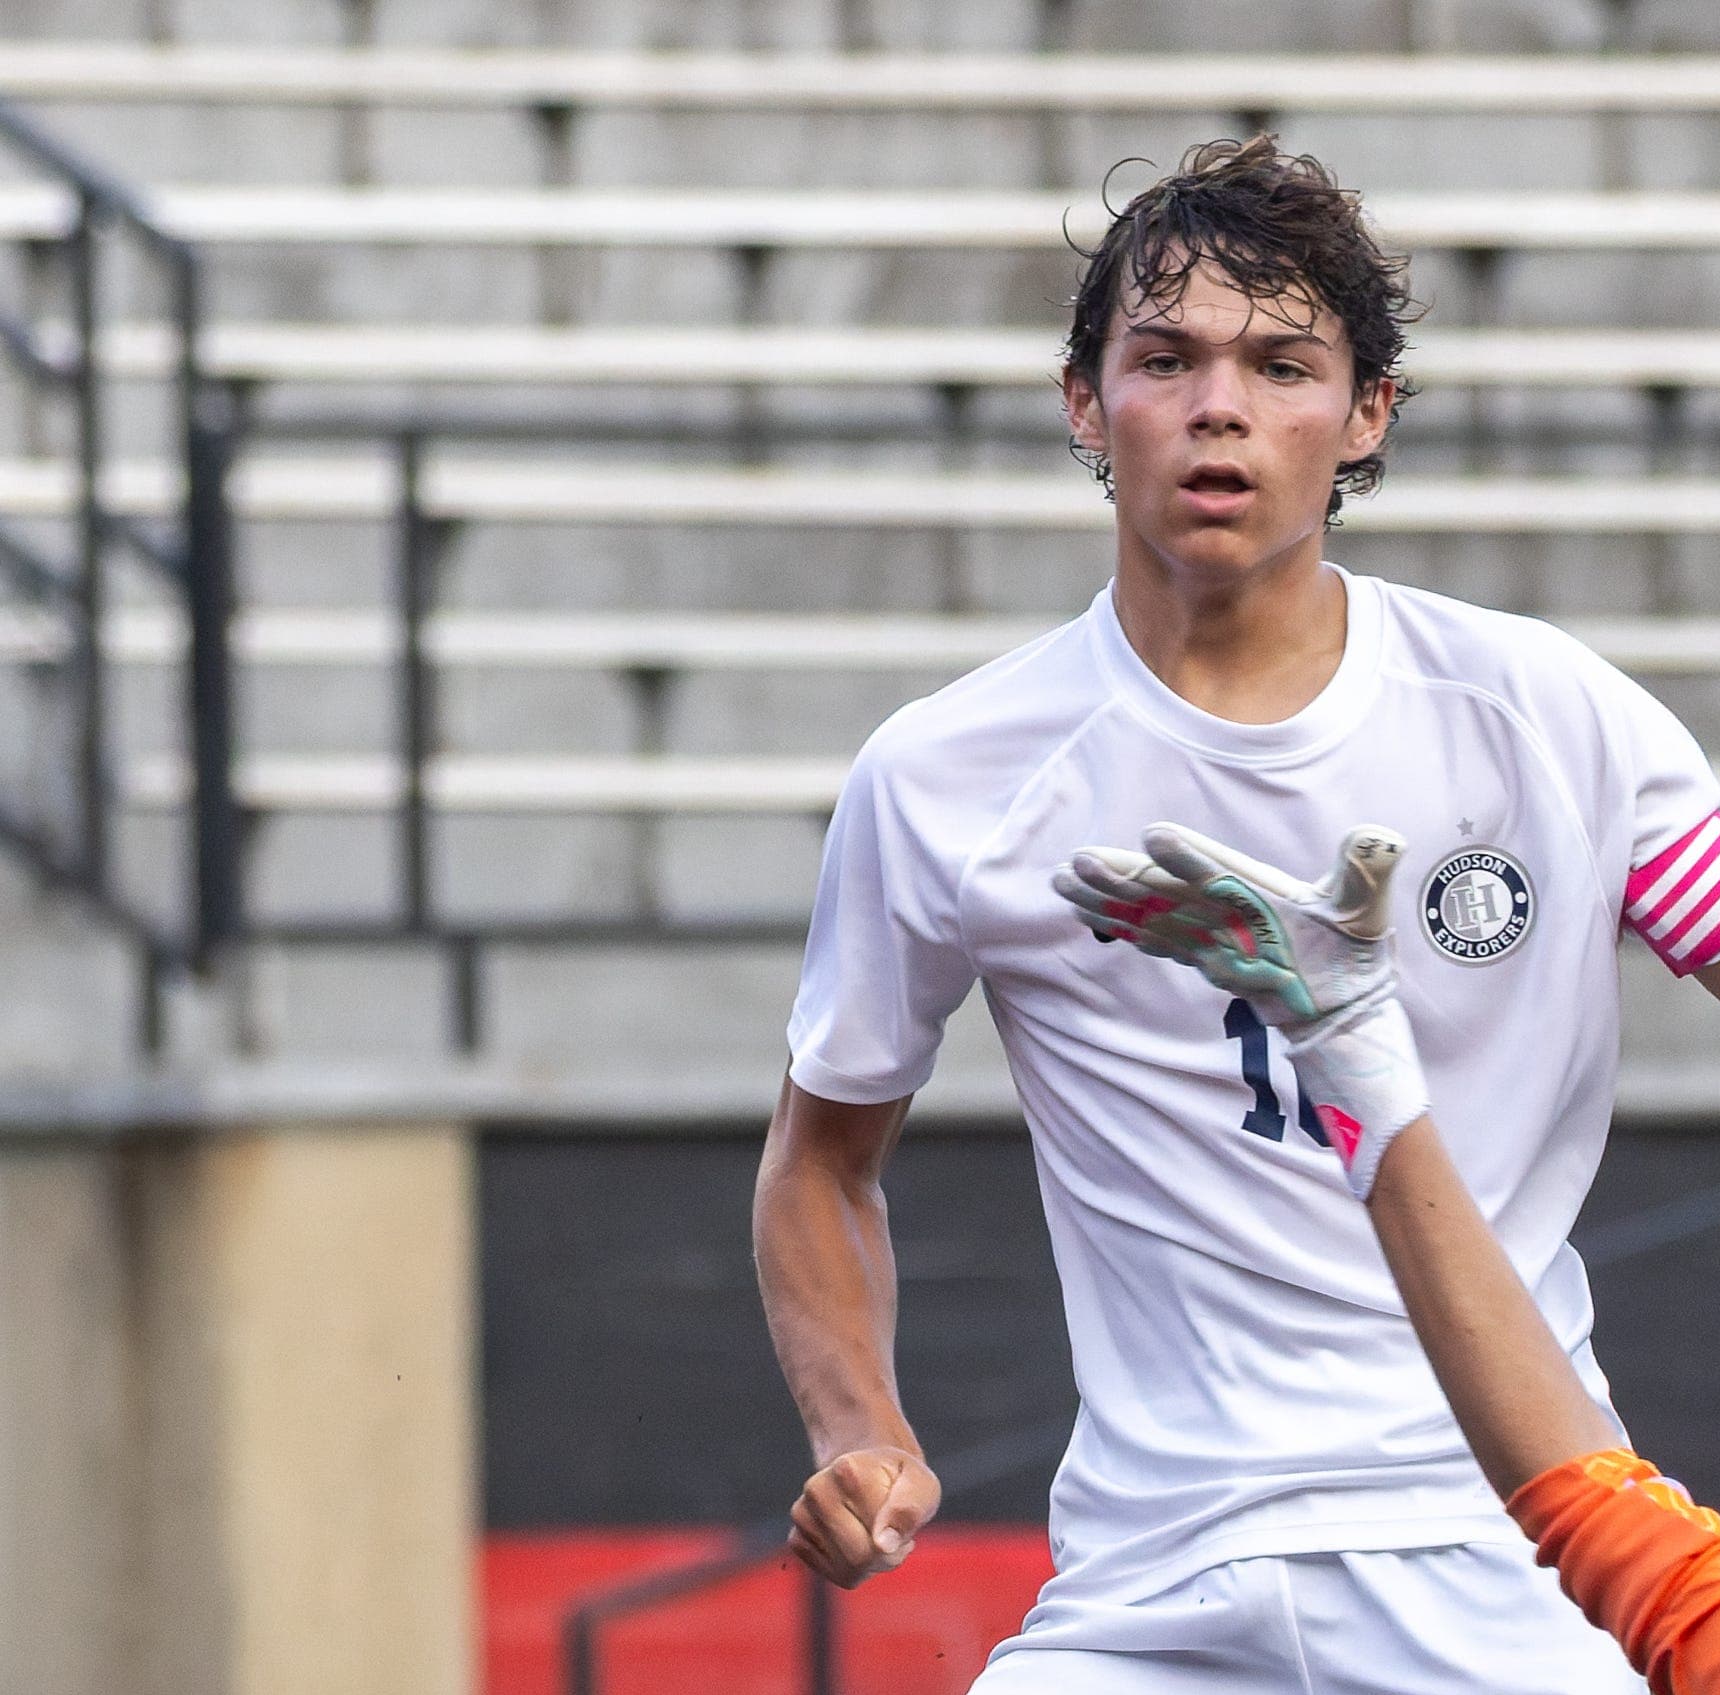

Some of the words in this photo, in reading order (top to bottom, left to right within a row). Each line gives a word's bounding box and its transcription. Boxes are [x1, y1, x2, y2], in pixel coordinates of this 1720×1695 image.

[1437, 854, 1507, 884] HUDSON
[1450, 883, 1502, 931] H
[1434, 914, 1526, 957] EXPLORERS
[1223, 997, 1336, 1148] 1
